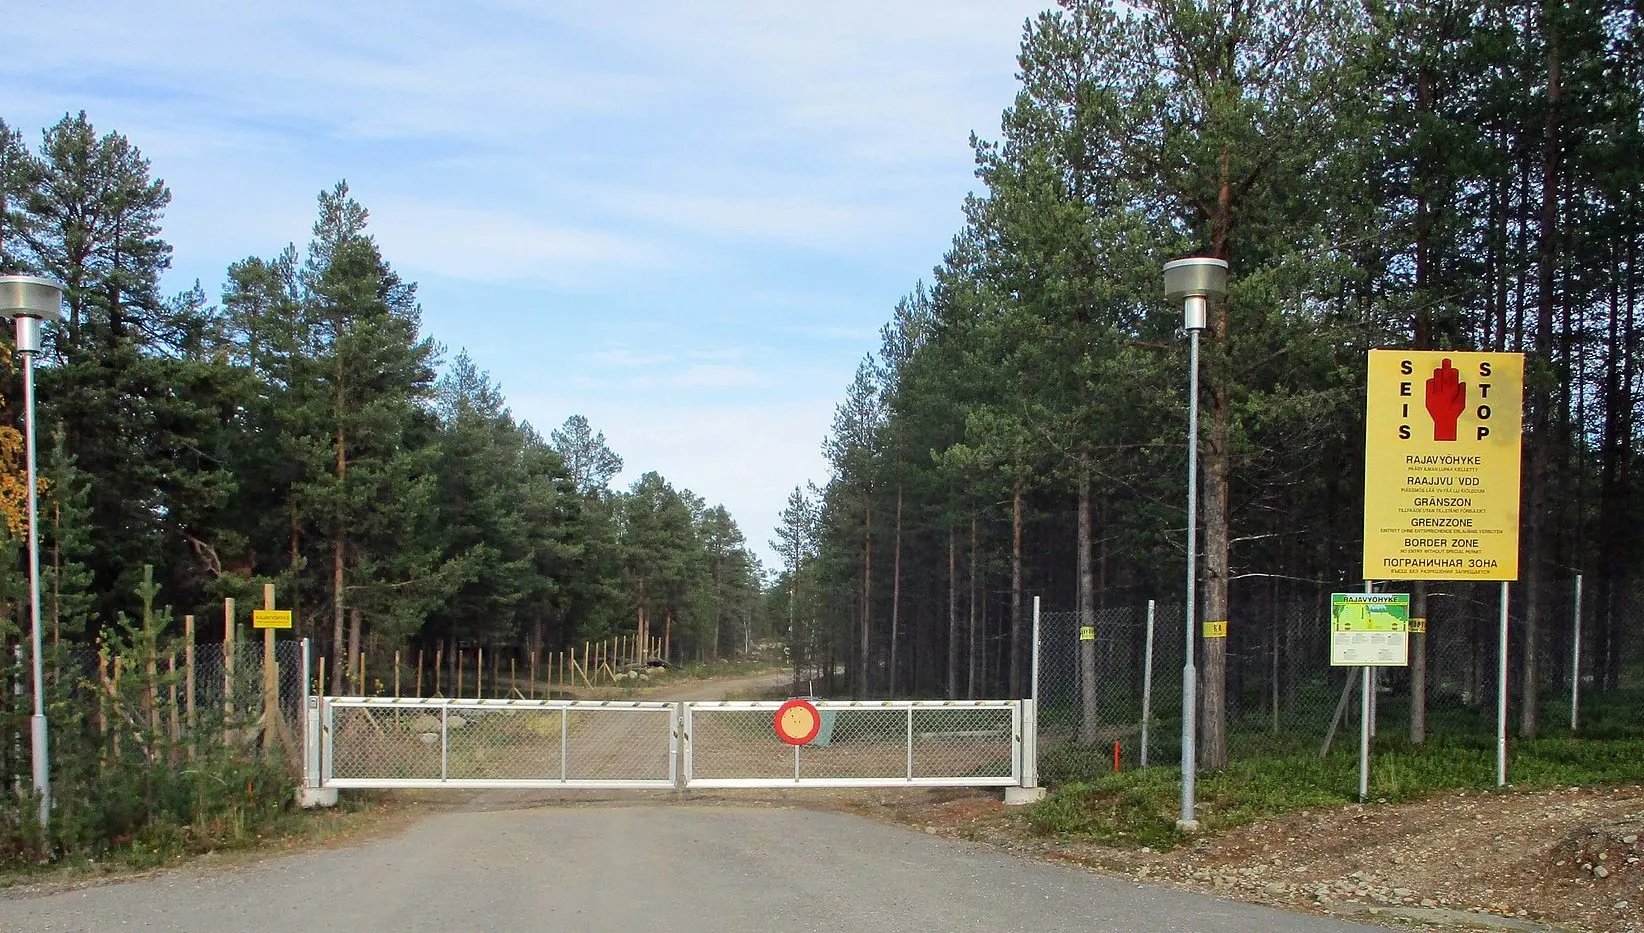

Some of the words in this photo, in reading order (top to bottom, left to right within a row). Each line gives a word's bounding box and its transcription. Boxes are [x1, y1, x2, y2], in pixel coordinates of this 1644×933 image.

[1399, 360, 1412, 440] SEIS
[1477, 362, 1491, 441] STOP
[1406, 454, 1481, 465] RAJAVYÖHYKE
[1414, 496, 1472, 507] GRÄNSZON
[1411, 518, 1473, 528] GRENZZONE
[1404, 539, 1447, 547] BORDER
[1451, 539, 1479, 548] ZONE
[1383, 558, 1463, 568] ПОГРАНИЧНАЯ
[1468, 559, 1498, 568] ЗОНА
